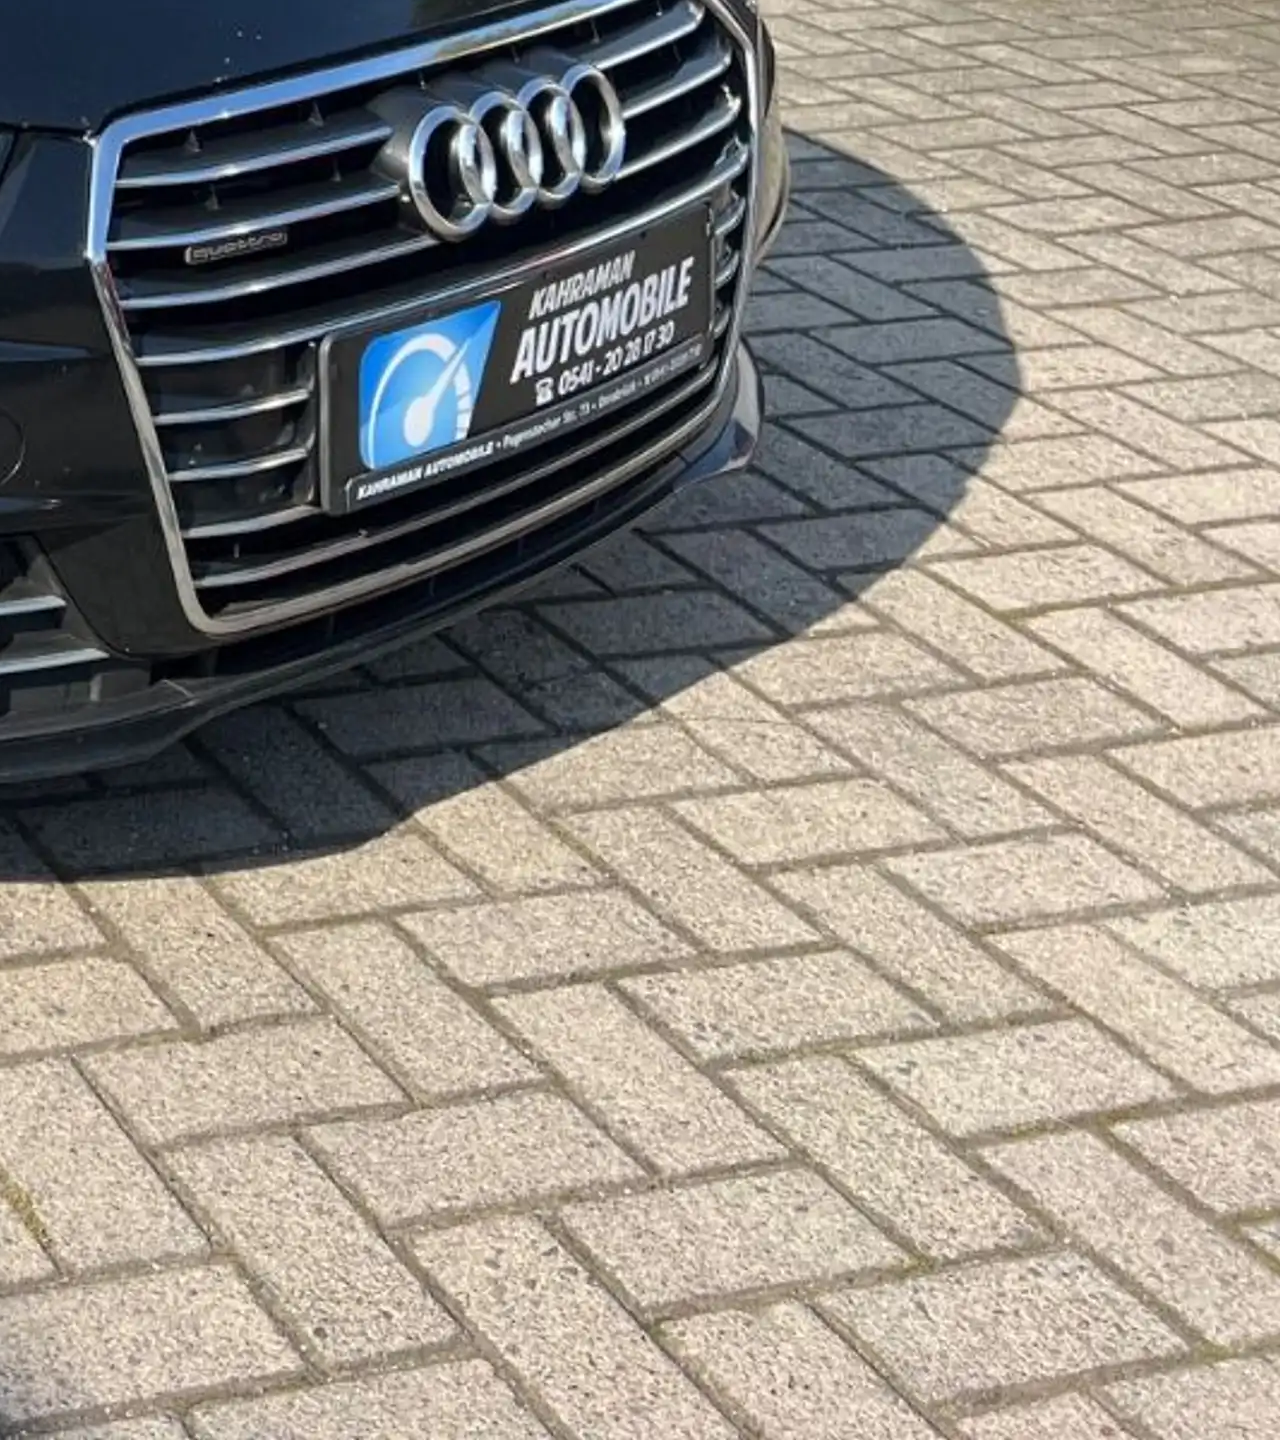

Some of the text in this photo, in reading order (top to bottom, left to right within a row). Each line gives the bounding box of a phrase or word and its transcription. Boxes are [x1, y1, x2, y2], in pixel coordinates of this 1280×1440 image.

[509, 256, 695, 385] AUTOMOBILE
[528, 249, 637, 321] KAHRAMAN
[557, 359, 595, 396] 0541
